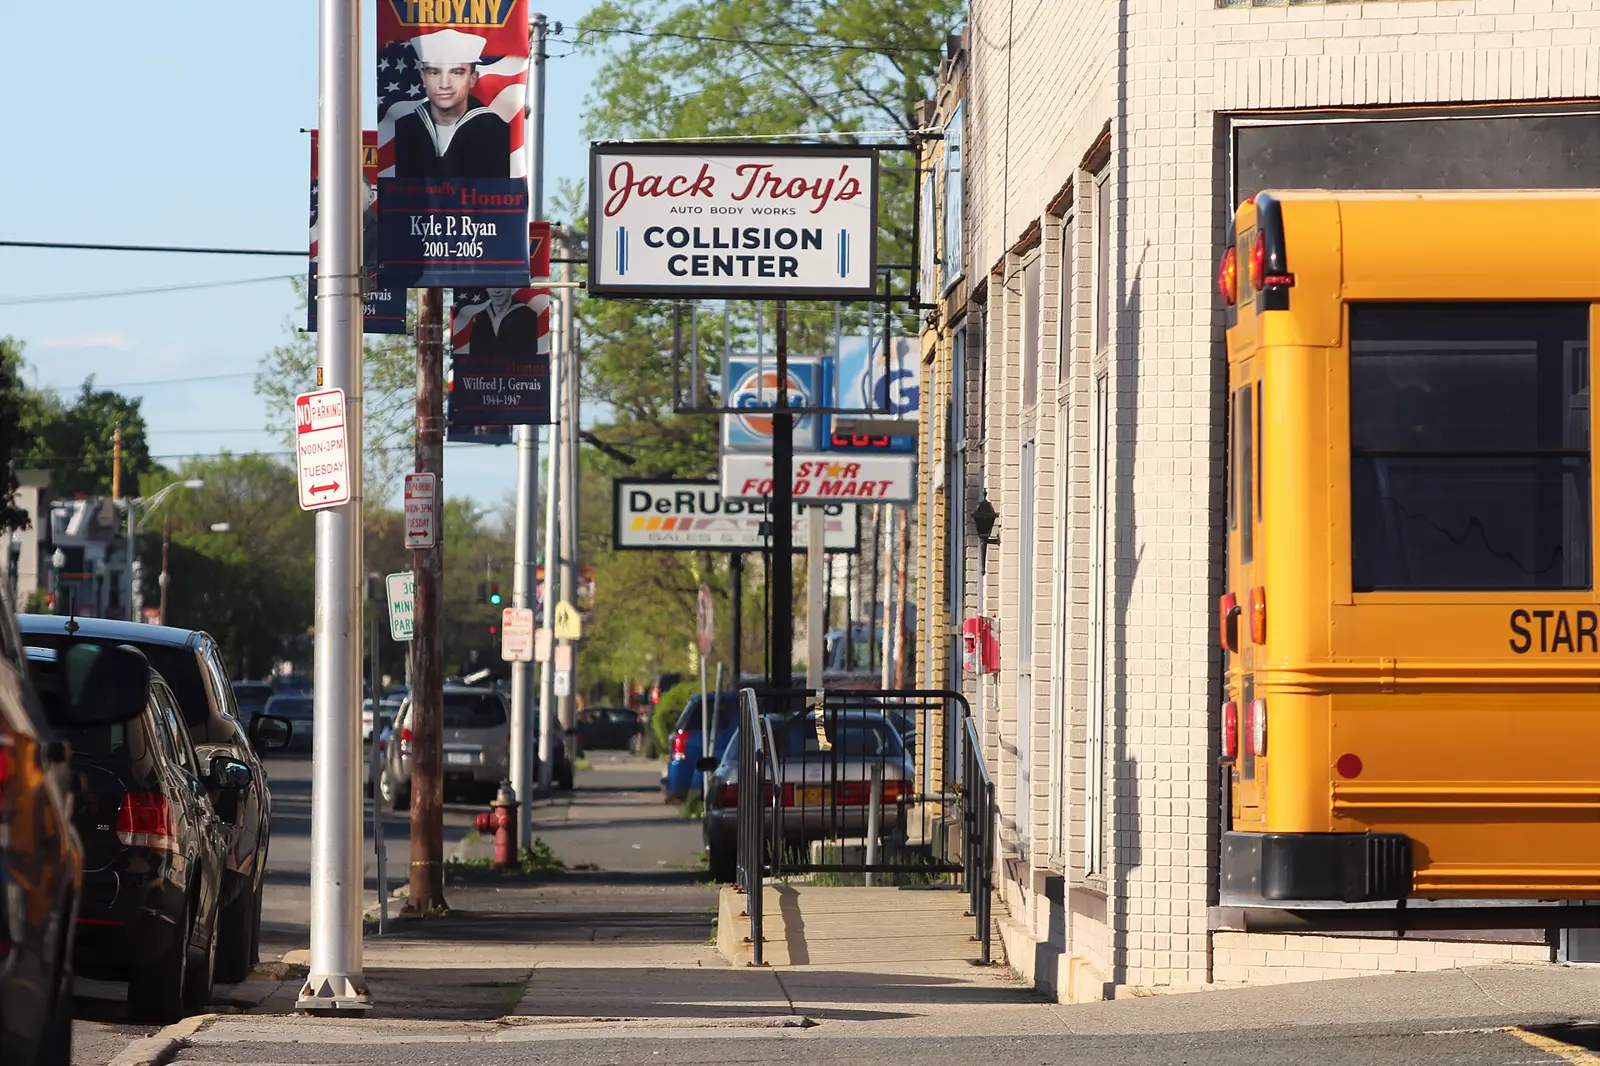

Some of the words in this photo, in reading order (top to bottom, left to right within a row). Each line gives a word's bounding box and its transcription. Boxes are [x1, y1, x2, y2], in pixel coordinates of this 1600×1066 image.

[460, 187, 524, 205] Honor
[604, 161, 716, 217] Jack
[731, 163, 863, 214] Troy's
[669, 206, 703, 214] AUTO
[710, 206, 744, 214] BODY
[751, 207, 796, 216] WORKS
[410, 214, 442, 242] Kyle
[445, 216, 457, 236] P.
[460, 216, 497, 242] Ryan
[643, 226, 823, 250] COLLISION
[667, 254, 799, 277] CENTER
[462, 377, 497, 390] Wilfred
[507, 378, 541, 391] Gervais
[297, 403, 311, 426] NO
[311, 402, 342, 421] PARKING
[300, 438, 344, 456] NOON-3PM
[303, 460, 345, 478] TUESDAY
[817, 480, 894, 497] MART
[407, 517, 430, 528] TUESDAY
[1509, 608, 1598, 654] STAR
